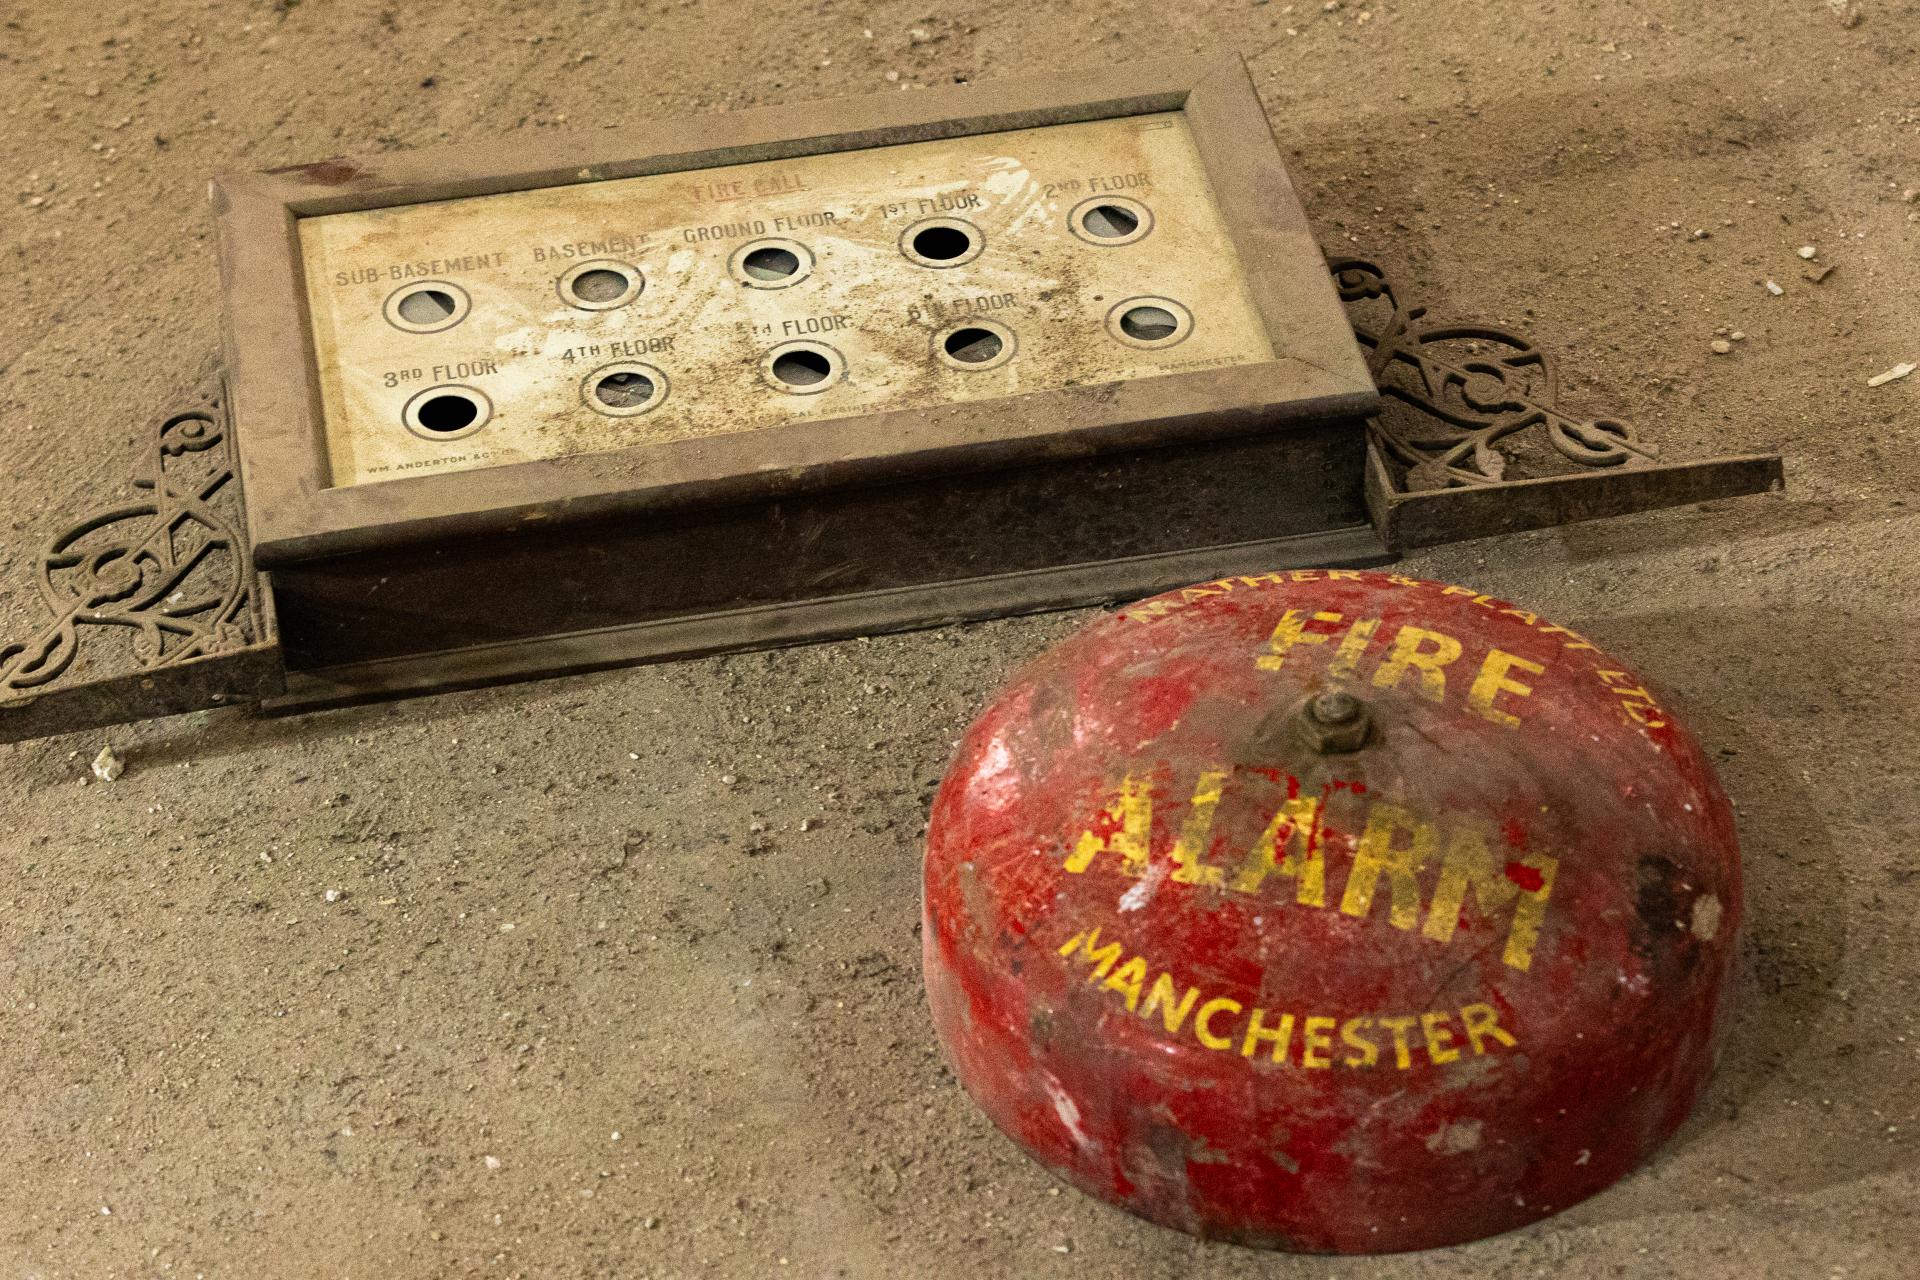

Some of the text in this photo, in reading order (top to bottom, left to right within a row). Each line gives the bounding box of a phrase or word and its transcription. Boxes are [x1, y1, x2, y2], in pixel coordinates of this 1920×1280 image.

[692, 174, 807, 200] FIRE CALL
[1042, 172, 1153, 198] 2ND FLOOR
[876, 193, 981, 219] 1ST FLOOR
[683, 211, 838, 243] GROUND FLOOR
[533, 233, 648, 262] BASEMENT
[336, 252, 504, 287] SUB-BASEMENT
[953, 292, 1018, 314] FLOOR
[782, 314, 848, 336] FLOOR
[561, 336, 676, 364] 4TH FLOOR
[383, 360, 498, 388] 3RD FLOOR
[396, 454, 467, 471] ANDERTON
[1125, 569, 1363, 623] MATHER
[1387, 574, 1421, 588] &
[1441, 585, 1602, 654] PLATT
[1255, 608, 1545, 731] FIRE
[1062, 769, 1559, 972] ALARM
[1058, 926, 1518, 1070] MANCHESTER
